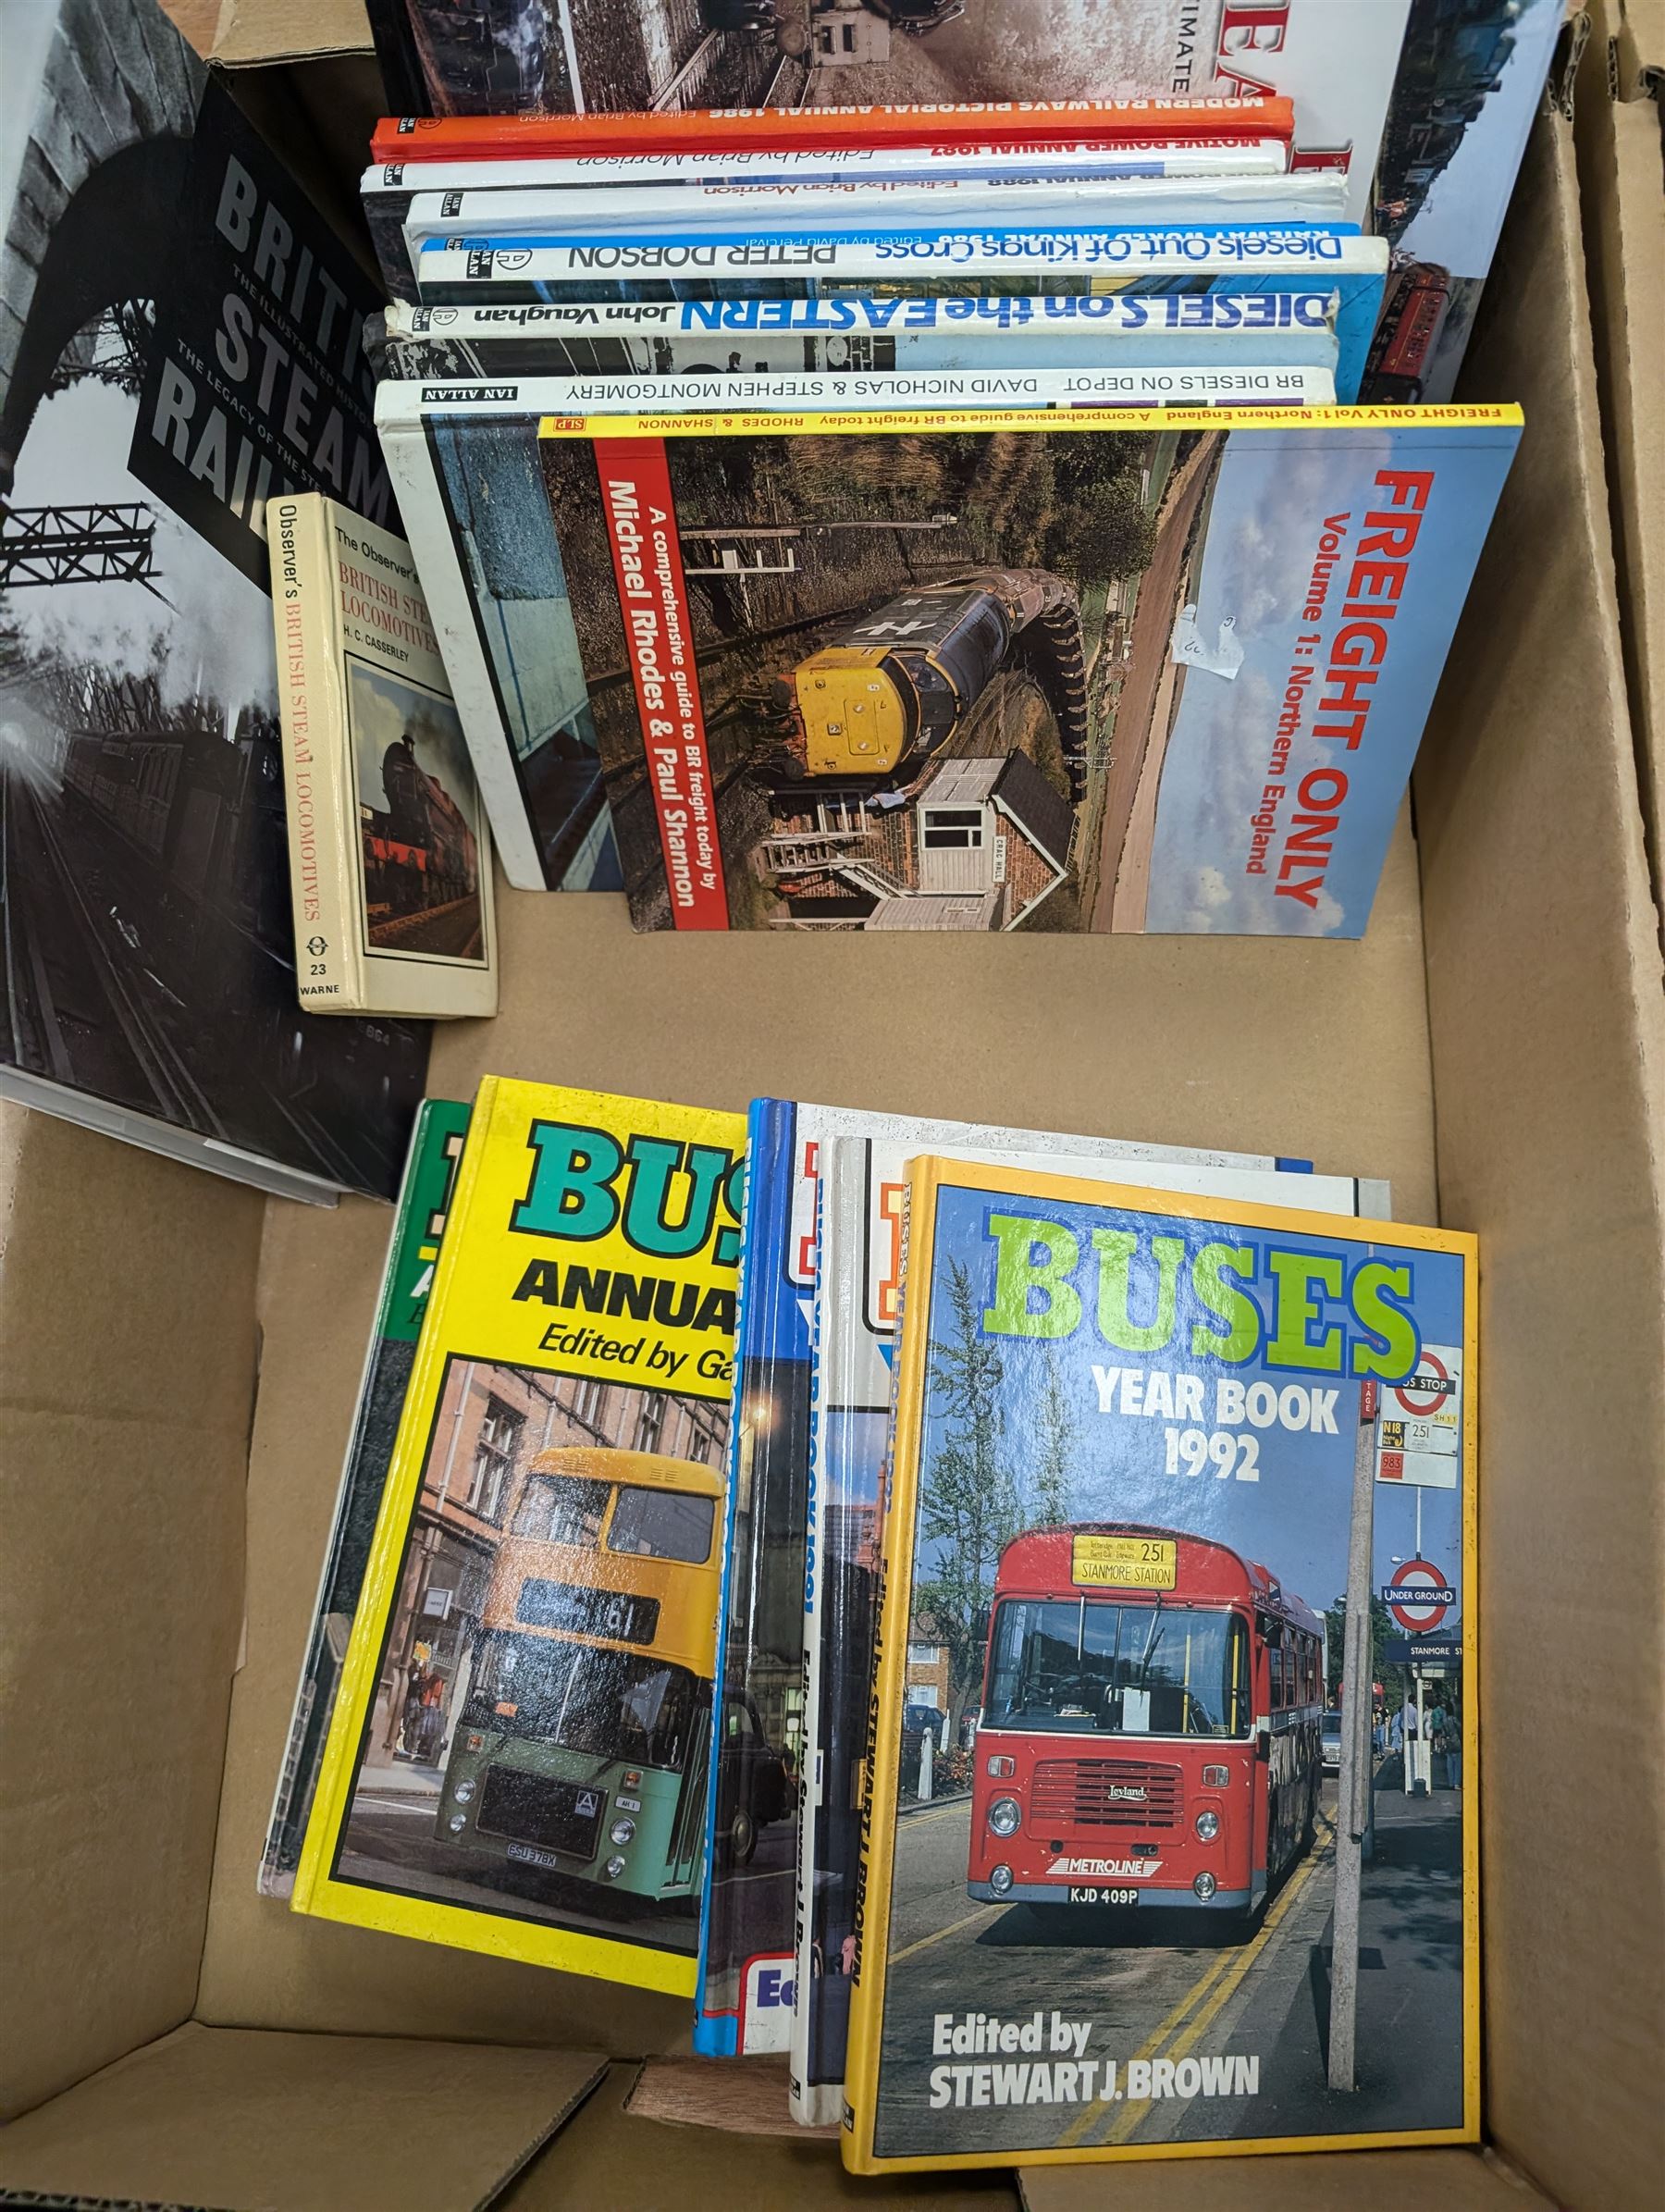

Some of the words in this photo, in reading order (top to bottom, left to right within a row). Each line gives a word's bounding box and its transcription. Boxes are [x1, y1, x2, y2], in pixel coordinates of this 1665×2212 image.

[1172, 0, 1201, 93] IMATE
[772, 104, 874, 117] ANNUAL
[880, 101, 1013, 114] PICTORIAL
[1018, 98, 1151, 112] RAILWAYS
[1154, 96, 1264, 110] MODERN
[519, 113, 585, 124] Morrison
[588, 112, 624, 122] Brian
[628, 110, 646, 120] by
[649, 110, 697, 121] Edited
[709, 107, 765, 118] 1986
[931, 147, 982, 157] 1987
[990, 142, 1079, 155] ANNUAL
[1085, 140, 1168, 151] POWER
[1174, 138, 1261, 149] MOTIVE
[577, 154, 686, 168] Morrison
[691, 152, 754, 166] Brian
[758, 152, 790, 164] by
[795, 149, 875, 163] Edited
[703, 184, 799, 197] Morrison
[802, 183, 856, 193] Brian
[858, 180, 887, 192] by
[890, 179, 958, 192] Edited
[443, 193, 453, 216] ALLAN
[451, 196, 462, 210] IAN
[569, 245, 717, 268] DOBSON
[727, 243, 837, 266] PETER
[874, 241, 974, 263] Cross
[981, 239, 1079, 263] Kings
[1085, 239, 1131, 263] Of
[1140, 238, 1210, 261] Out
[1217, 237, 1342, 262] Diesels
[474, 305, 599, 326] Vaughan
[606, 306, 677, 324] John
[680, 296, 938, 330] EASTERN
[944, 296, 1034, 328] the
[1044, 295, 1115, 318] on
[1121, 294, 1330, 329] DIESELS
[233, 263, 258, 301] THE
[259, 296, 336, 391] ILLUSTRATED
[727, 380, 824, 398] STEPHEN
[832, 381, 847, 396] &
[854, 379, 964, 396] NICHOLAS
[971, 378, 1038, 393] DAVID
[1063, 377, 1134, 392] DEPOT
[1141, 377, 1173, 390] ON
[1179, 375, 1269, 389] DIESELS
[1276, 374, 1304, 388] BR
[425, 389, 481, 401] ALLAN
[484, 389, 514, 400] IAN
[565, 383, 722, 400] MONTGOMERY
[178, 338, 205, 376] THE
[206, 372, 255, 426] LEGACY
[257, 423, 275, 444] OF
[278, 441, 300, 474] THE
[216, 292, 396, 528] STEAM
[1335, 409, 1363, 419] Vol
[1368, 409, 1416, 419] ONLY
[1421, 408, 1502, 418] FREIGHT
[638, 418, 714, 429] SHANNON
[722, 418, 734, 428] &
[741, 416, 804, 427] RHODES
[820, 414, 865, 426] today
[867, 414, 919, 426] freight
[924, 414, 946, 426] BR
[949, 415, 966, 425] to
[968, 412, 1014, 424] guide
[1017, 411, 1136, 423] comprehensive
[1139, 413, 1151, 422] A
[1166, 410, 1233, 422] England
[1238, 410, 1313, 421] Northern
[555, 419, 585, 431] SLP
[648, 505, 667, 525] A
[335, 525, 359, 552] The
[607, 479, 652, 599] Michael
[279, 503, 303, 599] Observer's
[1301, 512, 1351, 623] Volume
[339, 560, 399, 611] BRITISH
[652, 538, 685, 667] comprehensive
[1312, 469, 1435, 750] FREIGHT
[339, 589, 440, 657] LOCOMOTIVES
[285, 602, 306, 688] BRITISH
[343, 624, 353, 638] H.
[354, 629, 364, 644] C.
[364, 633, 410, 663] CASSERLEY
[1294, 632, 1320, 656] 1:
[630, 609, 665, 711] Rhodes
[671, 671, 694, 720] guide
[649, 720, 673, 738] &
[1267, 664, 1313, 777] Northern
[291, 695, 314, 765] STEAM
[683, 723, 695, 741] to
[685, 745, 703, 768] BR
[653, 748, 680, 803] Paul
[687, 774, 709, 823] freight
[1245, 784, 1286, 875] England
[1274, 767, 1350, 910] ONLY
[295, 771, 321, 922] LOCOMOTIVES
[695, 826, 716, 871] today
[663, 807, 696, 908] Shannon
[699, 871, 716, 891] by
[310, 963, 327, 976] 23
[300, 983, 340, 995] WARNE
[898, 1182, 913, 1277] BUSES
[980, 1207, 1421, 1382] BUSES
[893, 1280, 907, 1354] YEAR
[537, 1322, 648, 1370] Edited
[646, 1338, 689, 1381] by
[1420, 1379, 1448, 1391] STOP
[889, 1360, 903, 1444] BOOK
[1090, 1365, 1205, 1422] YEAR
[1216, 1378, 1340, 1435] BOOK
[1383, 1421, 1401, 1434] N18
[1412, 1424, 1429, 1439] 251
[1165, 1427, 1261, 1482] 1992
[1383, 1456, 1401, 1469] 983
[1141, 1542, 1164, 1563] 251
[1081, 1563, 1131, 1581] STANMORE
[1133, 1566, 1171, 1584] STATION
[1411, 1647, 1450, 1656] STANMORE
[860, 1692, 880, 1837] STEWART
[1068, 1858, 1144, 1875] METROLINE
[1070, 1887, 1098, 1903] KJD
[1101, 1888, 1139, 1904] 409P
[851, 1859, 869, 1988] BROWN
[932, 2011, 1043, 2056] Edited
[1049, 2010, 1092, 2058] by
[929, 2060, 1099, 2109] STEWART
[1100, 2059, 1123, 2102] J.
[1127, 2055, 1260, 2100] BROWN
